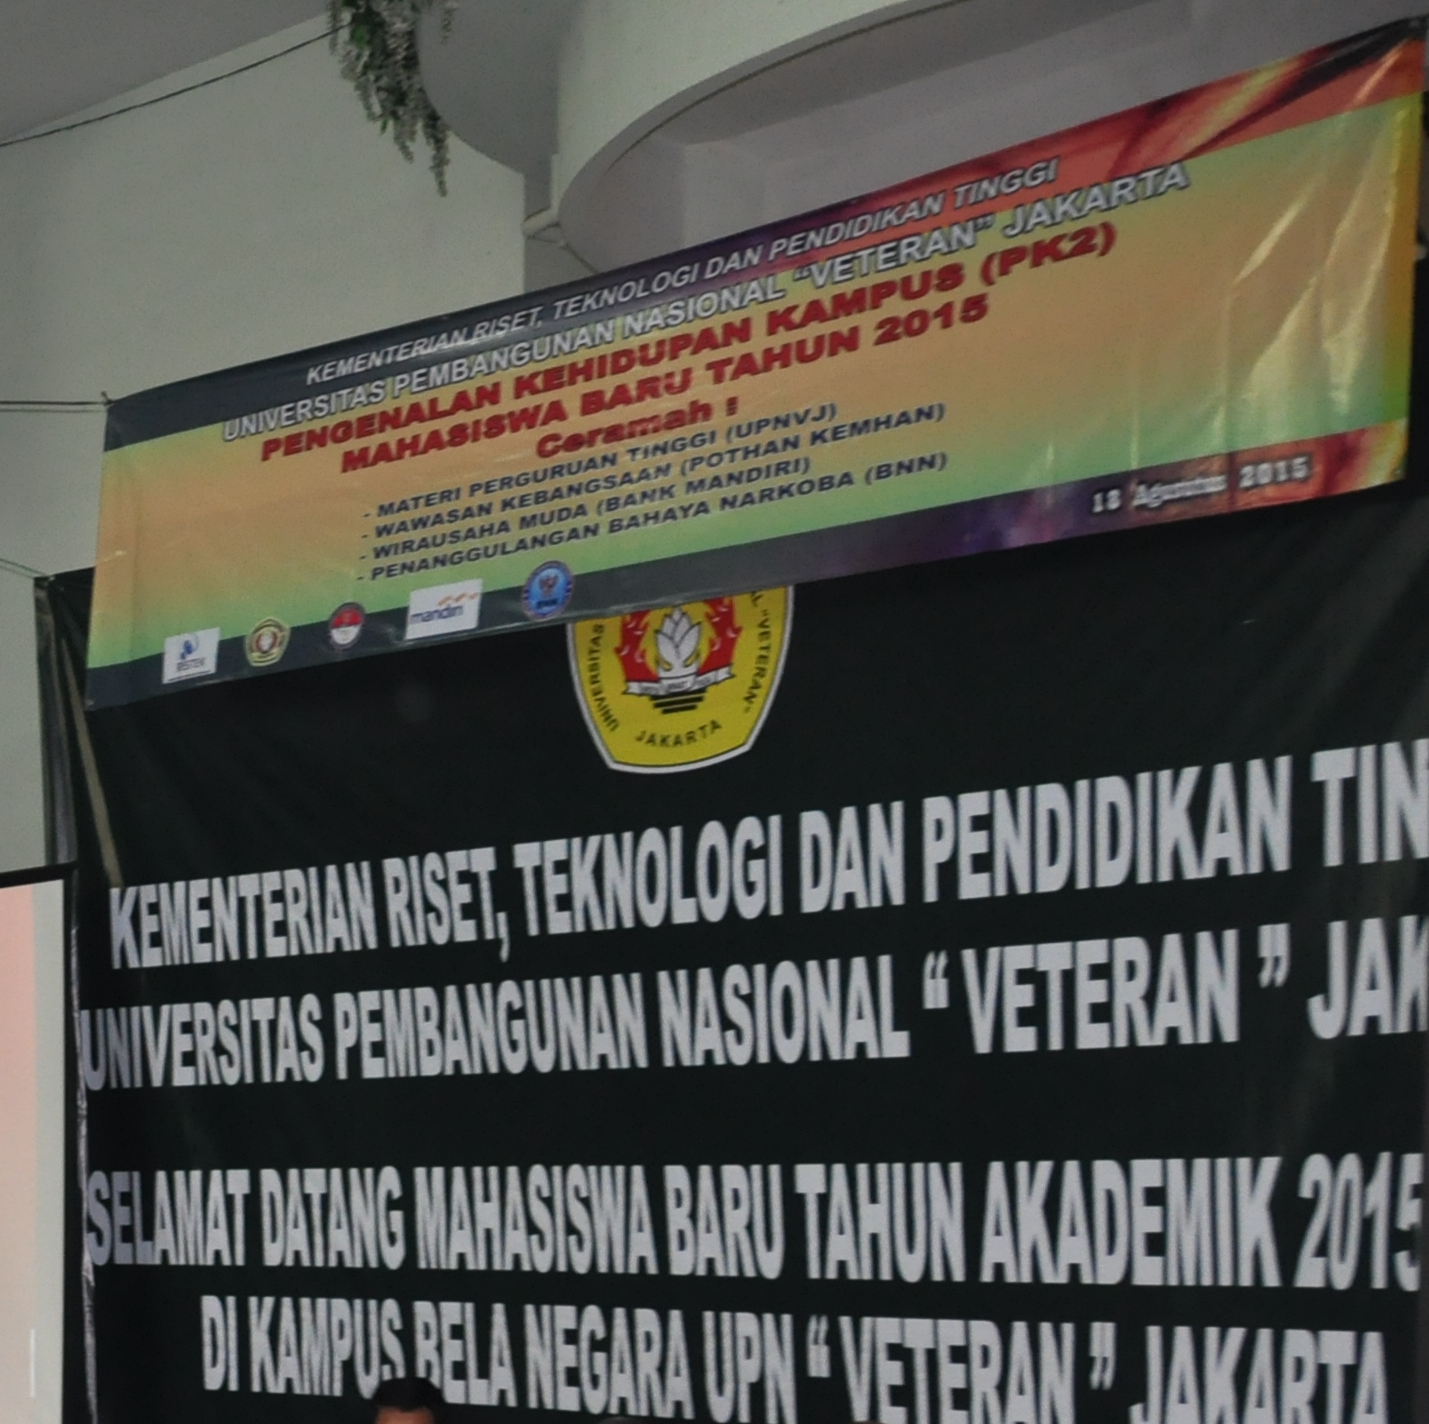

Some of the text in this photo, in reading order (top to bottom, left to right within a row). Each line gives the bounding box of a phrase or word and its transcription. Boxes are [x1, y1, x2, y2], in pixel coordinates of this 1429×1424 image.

[223, 380, 386, 442] UNIVERSITAS
[393, 323, 614, 398] PEMBANGUNAN
[622, 278, 786, 341] NASIONAL
[1003, 162, 1192, 238] JAKARTA
[306, 327, 468, 386] KEMENTERIAN
[553, 265, 700, 320] TEKNOLOGI
[704, 248, 763, 281] DAN
[768, 192, 946, 261] PENDIDIKAN
[953, 155, 1060, 209] TINGGI
[261, 220, 1117, 462] PENGENALAN KEHIDUPAN KAMPUS (PK2)
[340, 293, 989, 474] MAHASISWA BARU TAHUN 2015
[374, 502, 492, 539] WAWASAN
[500, 463, 671, 514] KEBANGSAAN
[680, 434, 801, 477] (POTHAN
[810, 402, 946, 446] KEMHAN)
[377, 486, 461, 517] MATERI
[468, 452, 617, 498] PERGURUAN
[627, 429, 717, 461] TINGGI
[726, 402, 837, 444] (UPNVJ)
[535, 399, 713, 459] Ceramah
[1092, 489, 1121, 514] 18
[1238, 454, 1311, 489] 2015
[370, 523, 600, 582] PENANGGULANGAN
[607, 502, 711, 535] BAHAYA
[719, 471, 855, 512] NARKOBA
[864, 452, 947, 486] (BNN)
[372, 520, 511, 561] WIRAUSAHA
[519, 505, 588, 532] MUDA
[596, 483, 677, 517] (BANK
[685, 456, 811, 494] MANDIRI)
[635, 718, 723, 748] JAKARTA
[110, 861, 377, 969] KEMENTERIAN
[382, 847, 510, 962] RISET,
[513, 814, 783, 936] TEKNOLOGI
[799, 800, 905, 913] DAN
[923, 755, 1293, 902] PENDIDIKAN
[80, 993, 324, 1091] UNIVERSITAS
[333, 972, 648, 1079] PEMBANGUNAN
[657, 954, 910, 1067] NASIONAL
[86, 1151, 1424, 1291] SELAMAT DATANG MAHASISWA BARU TAHUN AKADEMIK 2015
[201, 1295, 239, 1391] DI
[248, 1296, 406, 1399] KAMPUS
[413, 1301, 517, 1407] BELA
[524, 1304, 695, 1419] NEGARA
